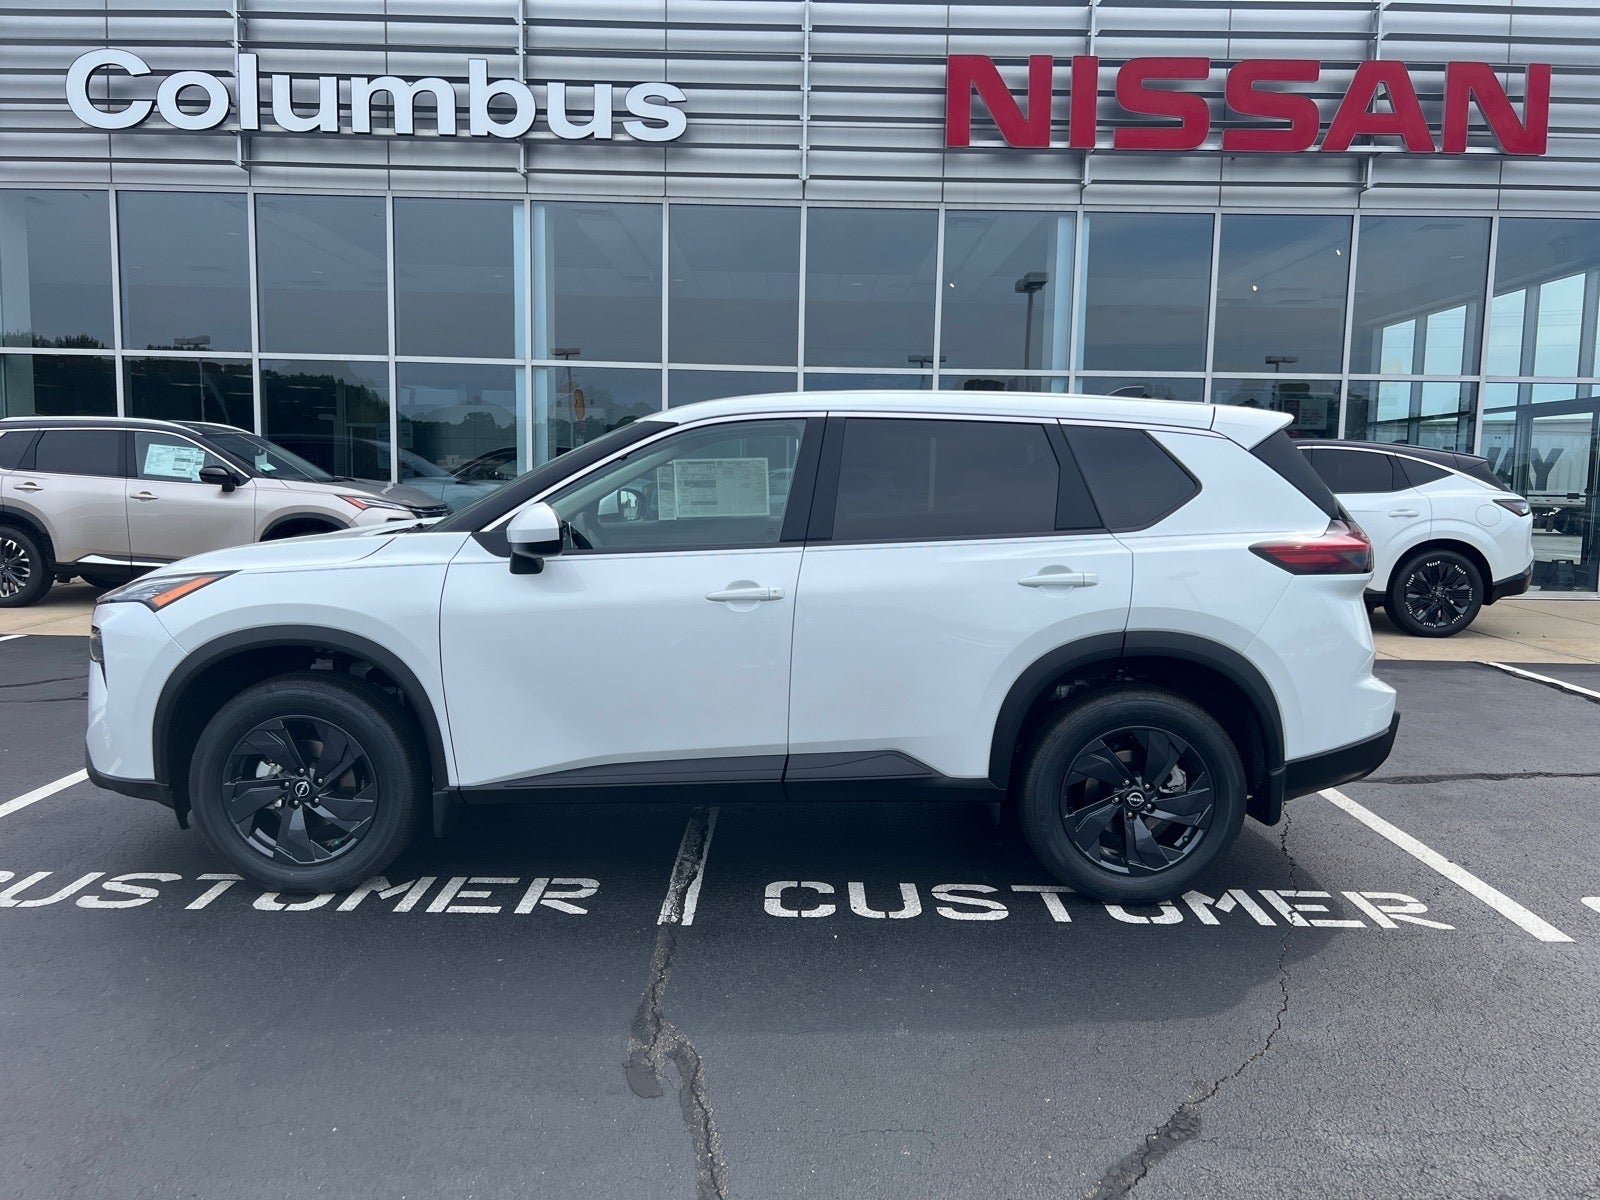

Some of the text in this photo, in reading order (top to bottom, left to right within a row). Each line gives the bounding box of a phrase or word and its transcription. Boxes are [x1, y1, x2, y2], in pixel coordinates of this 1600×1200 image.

[65, 48, 688, 143] Columbus
[945, 54, 1551, 155] NISSAN
[0, 870, 600, 915] USTOMER
